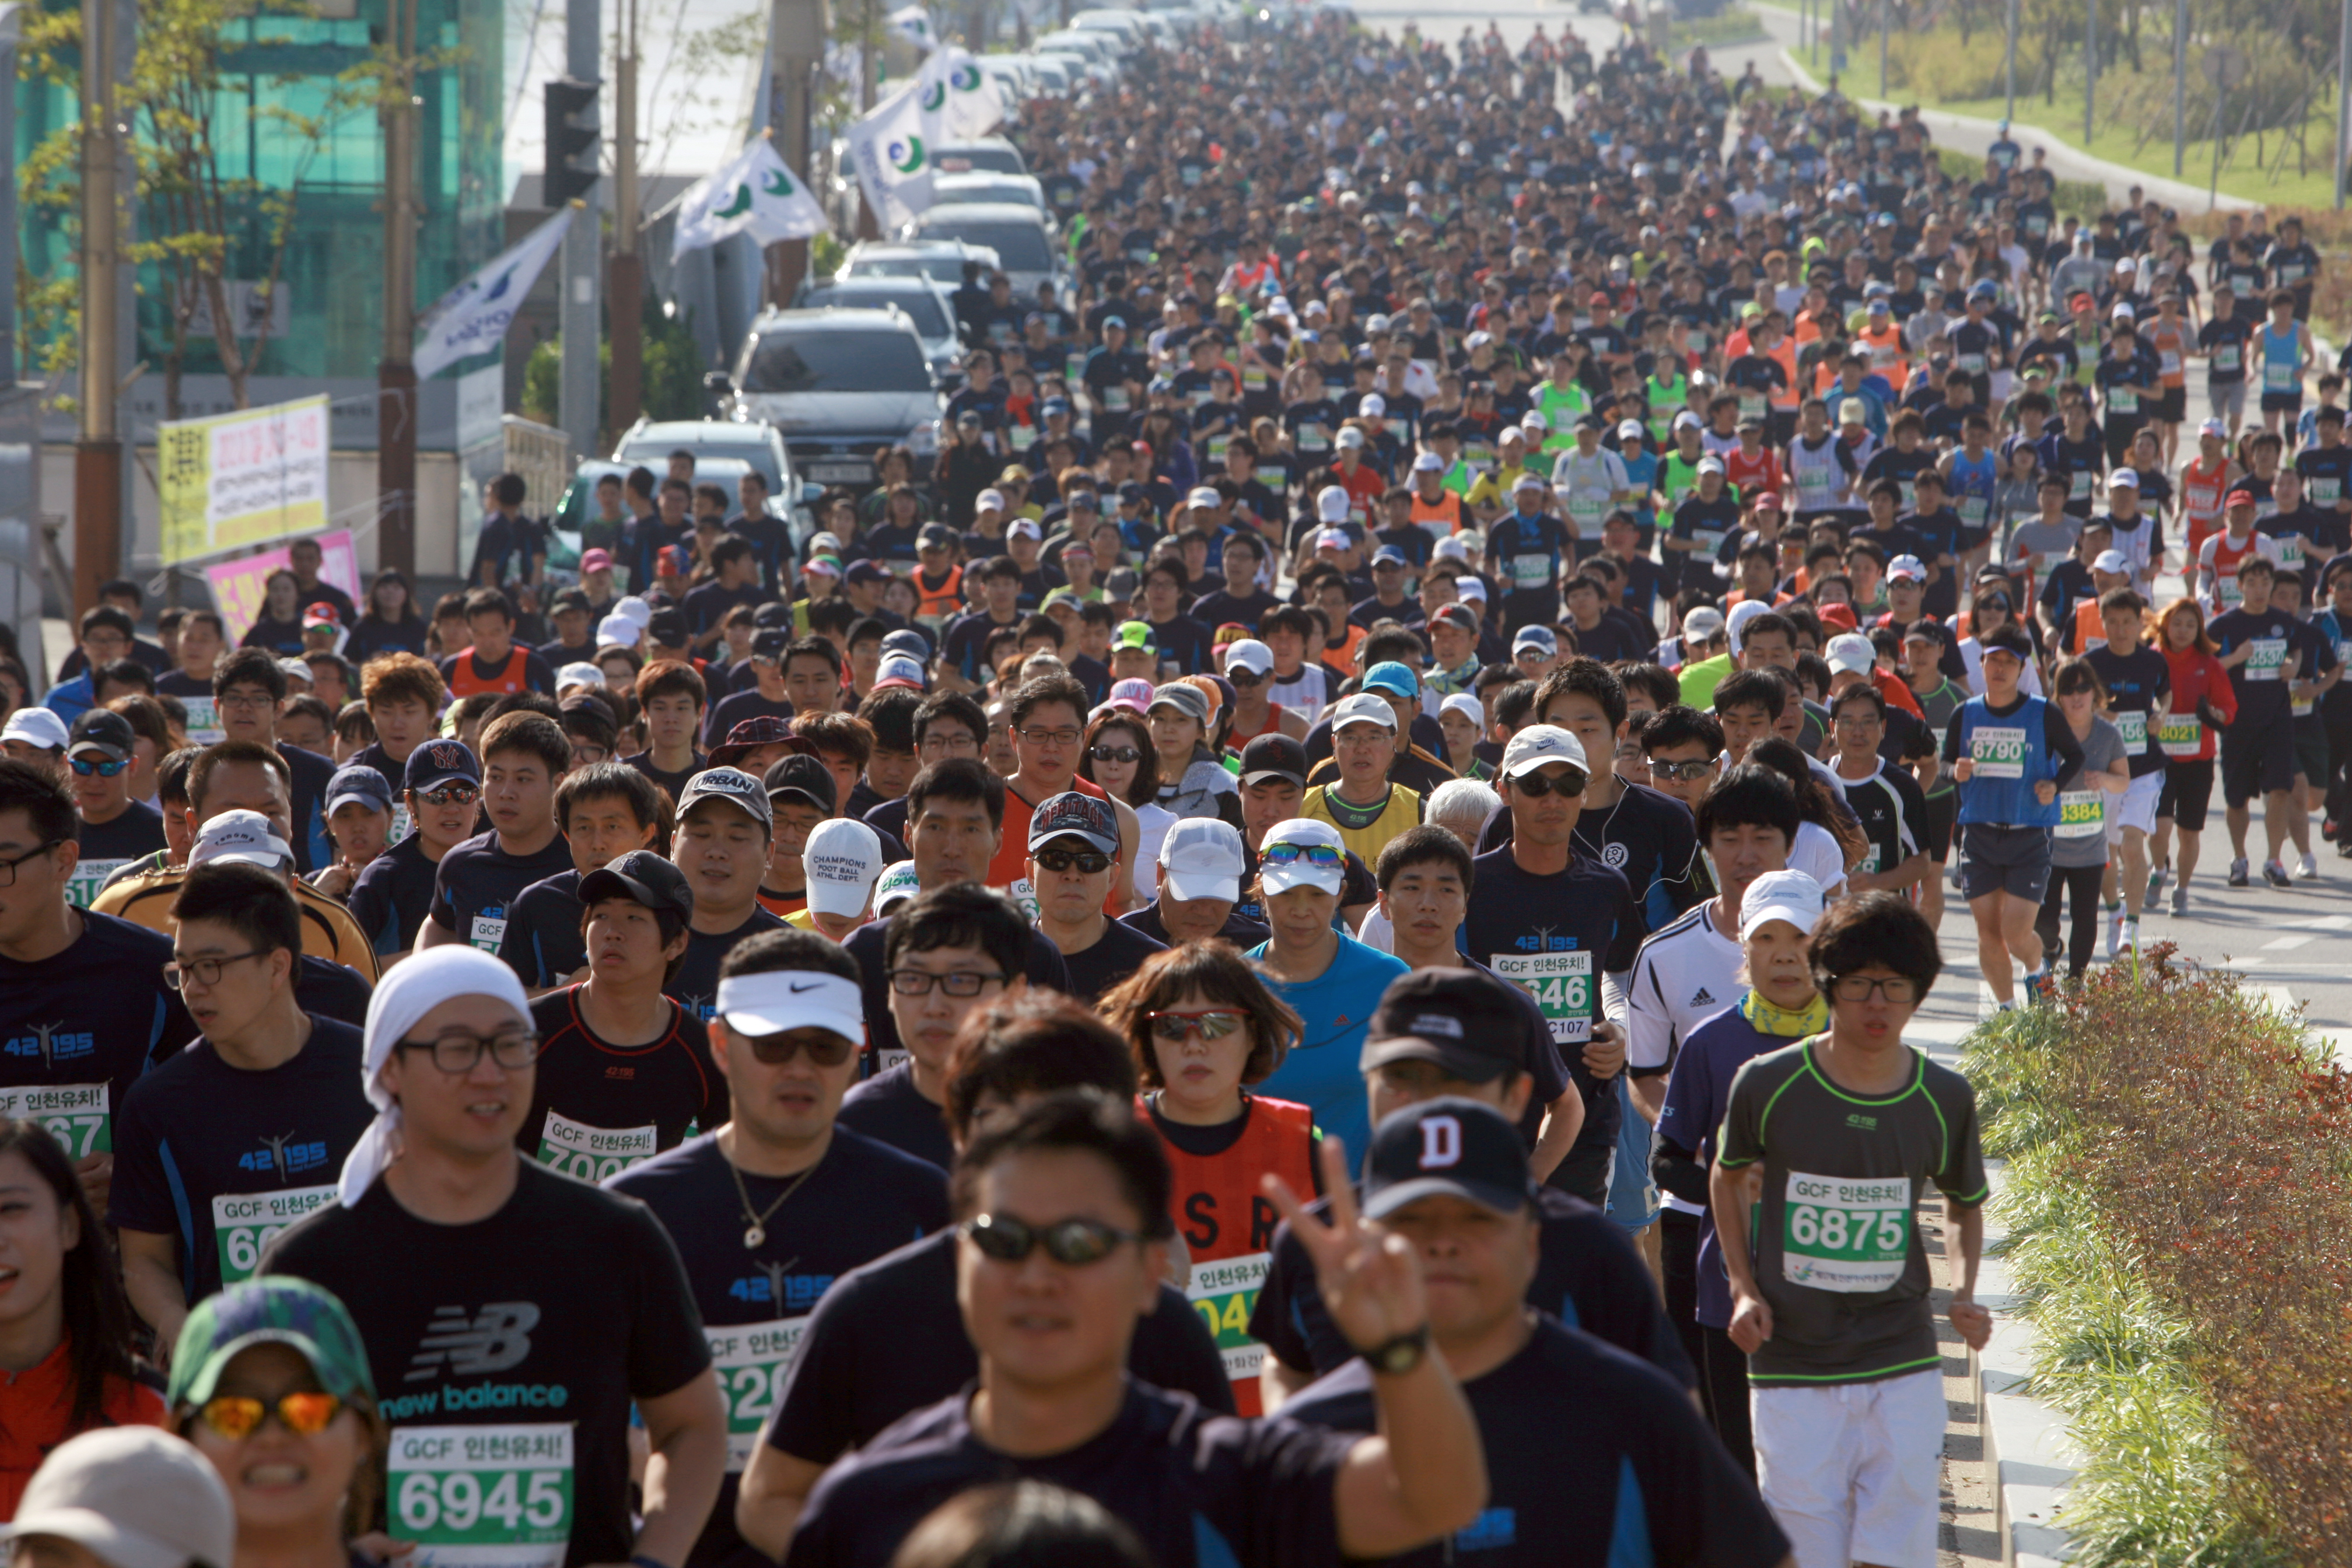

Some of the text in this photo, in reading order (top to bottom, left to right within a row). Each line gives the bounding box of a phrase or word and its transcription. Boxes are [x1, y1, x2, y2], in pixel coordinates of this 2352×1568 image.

[1115, 682, 1149, 700] NAVY
[2159, 725, 2197, 741] 8021
[430, 744, 460, 769] NY
[1973, 740, 2022, 760] 6790
[1041, 800, 1105, 834] HERITAGE
[813, 855, 866, 870] CHAMPIONS
[818, 864, 859, 875] FOOT BALL
[838, 874, 859, 883] DEPT.
[481, 907, 503, 919] 42
[1240, 904, 1259, 916] 42
[478, 923, 502, 936] GCF
[1515, 936, 1578, 950] 42 195
[1499, 957, 1584, 972] GCF 인천유치!
[1690, 998, 1716, 1008] adidas
[4, 1032, 94, 1056] 42 195
[25, 1088, 102, 1111] 인천유치!
[551, 1122, 650, 1152] GCF 인천유치!
[1418, 1114, 1463, 1169] D
[239, 1141, 327, 1171] 42 195
[545, 1142, 649, 1181] 700
[1796, 1180, 1903, 1203] GCF 인천유치!
[224, 1201, 262, 1219] GCF
[1185, 1192, 1219, 1249] S
[1791, 1205, 1904, 1251] 6875
[729, 1276, 771, 1302] 42
[1192, 1291, 1259, 1338] 04
[378, 1380, 568, 1421] new balance
[403, 1435, 564, 1462] GCF 인천유치!
[398, 1471, 565, 1531] 6945
